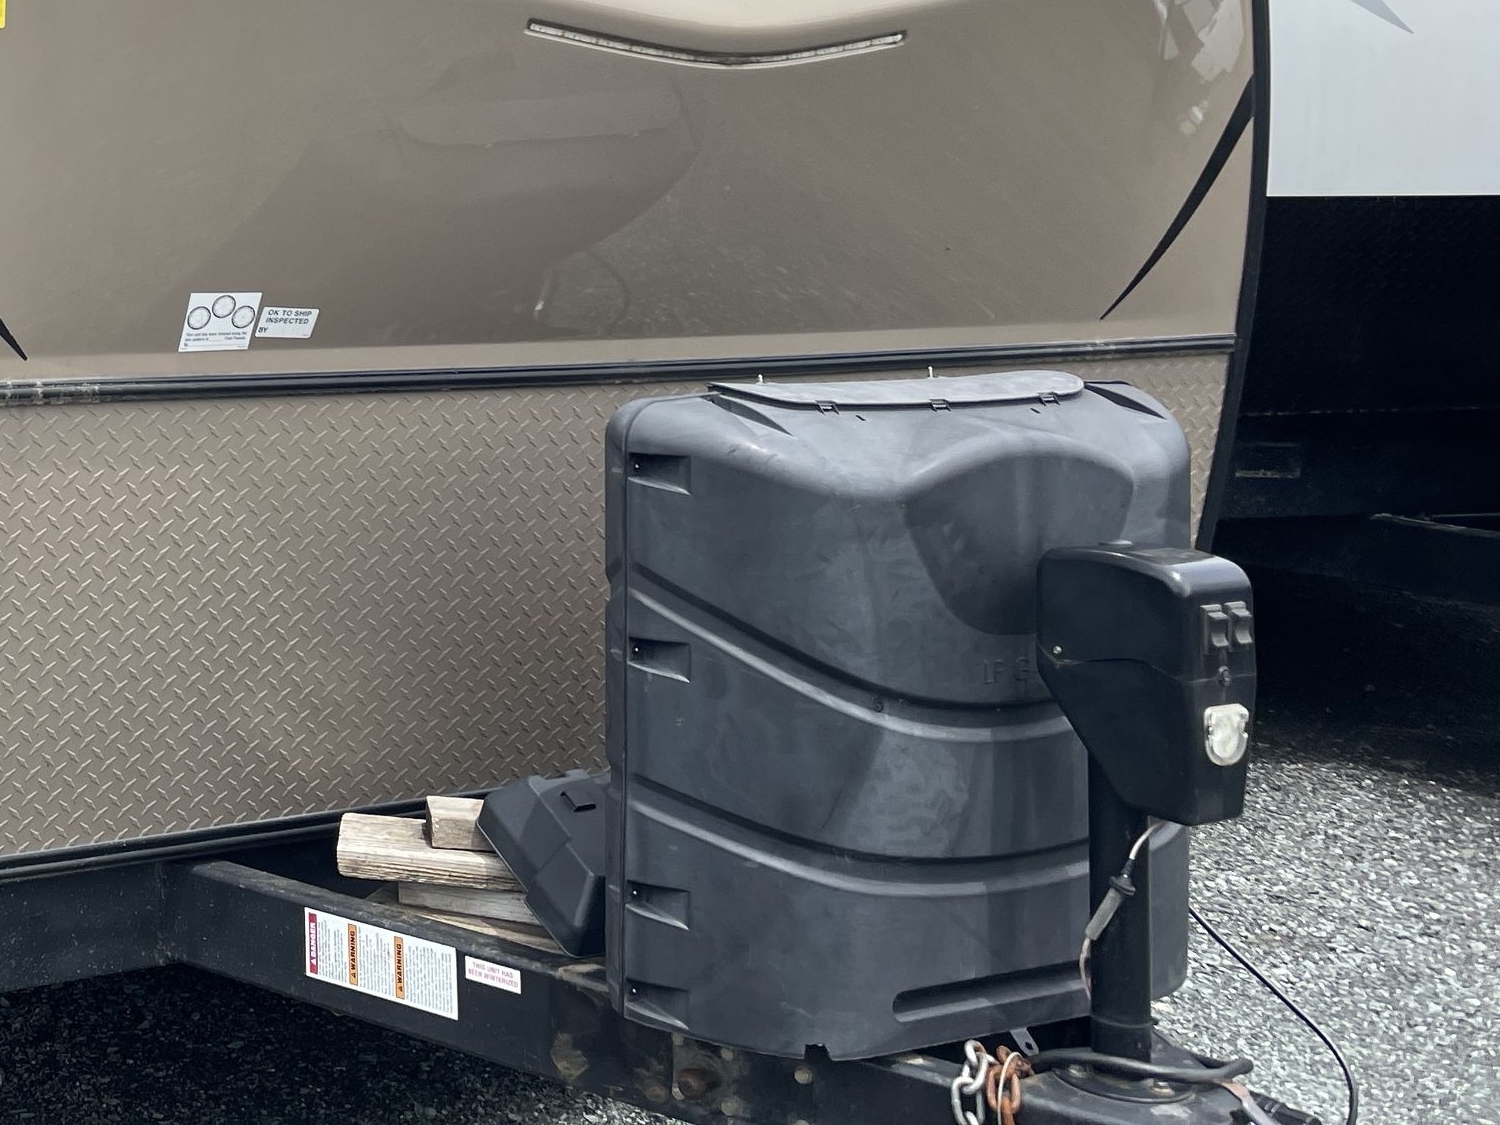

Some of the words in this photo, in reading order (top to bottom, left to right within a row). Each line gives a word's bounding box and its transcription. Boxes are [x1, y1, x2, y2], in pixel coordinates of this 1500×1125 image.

[268, 308, 279, 316] OK
[282, 309, 293, 317] TO
[294, 309, 313, 318] SHIP
[265, 316, 310, 325] INSPECTED
[309, 922, 317, 957] DANGER
